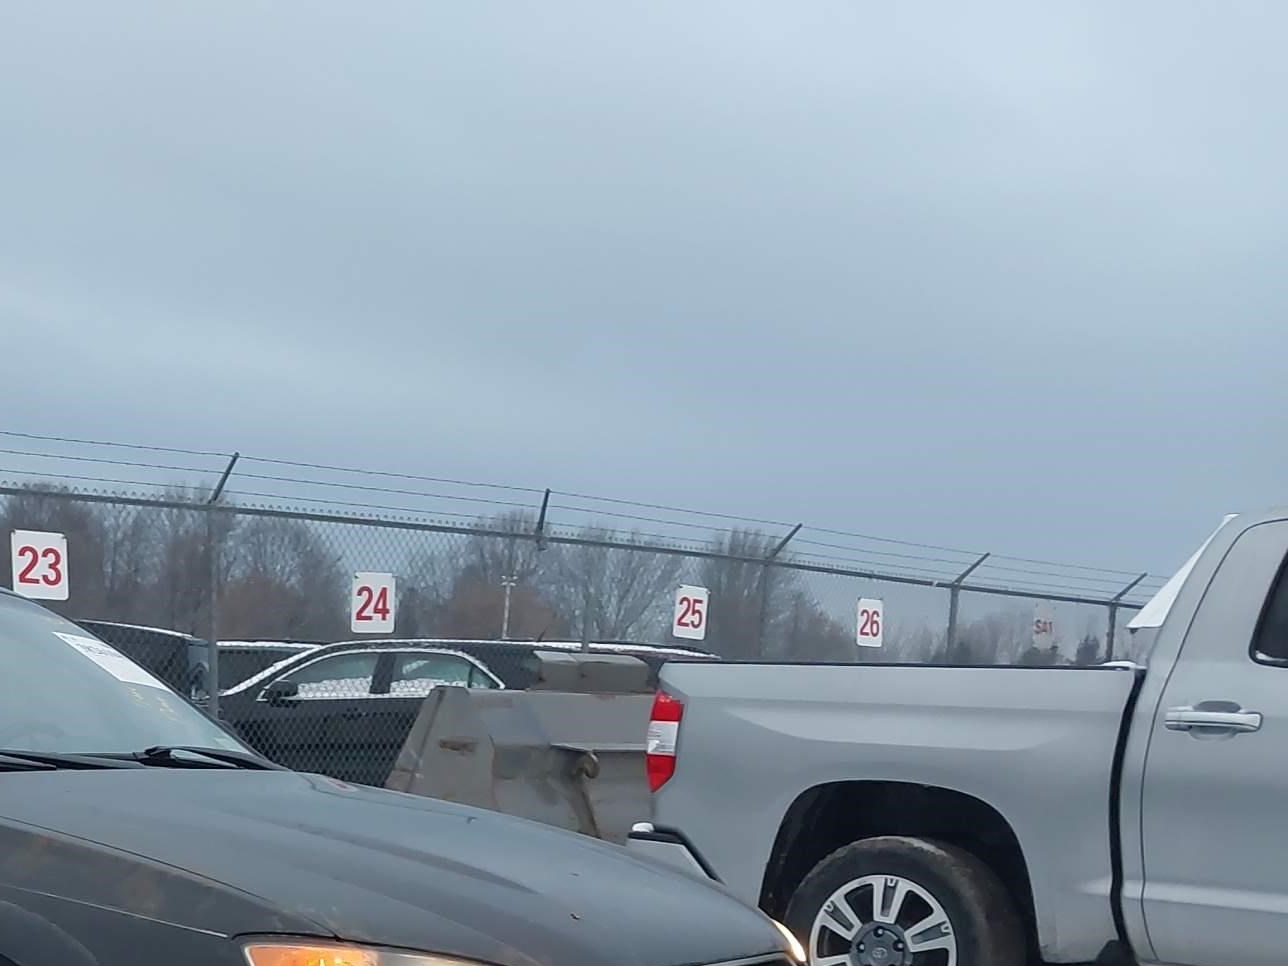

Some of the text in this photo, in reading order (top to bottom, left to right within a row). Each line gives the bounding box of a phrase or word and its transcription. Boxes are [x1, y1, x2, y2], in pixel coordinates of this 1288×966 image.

[17, 545, 62, 587] 23
[355, 586, 390, 621] 24
[676, 596, 703, 628] 25
[859, 609, 880, 637] 26
